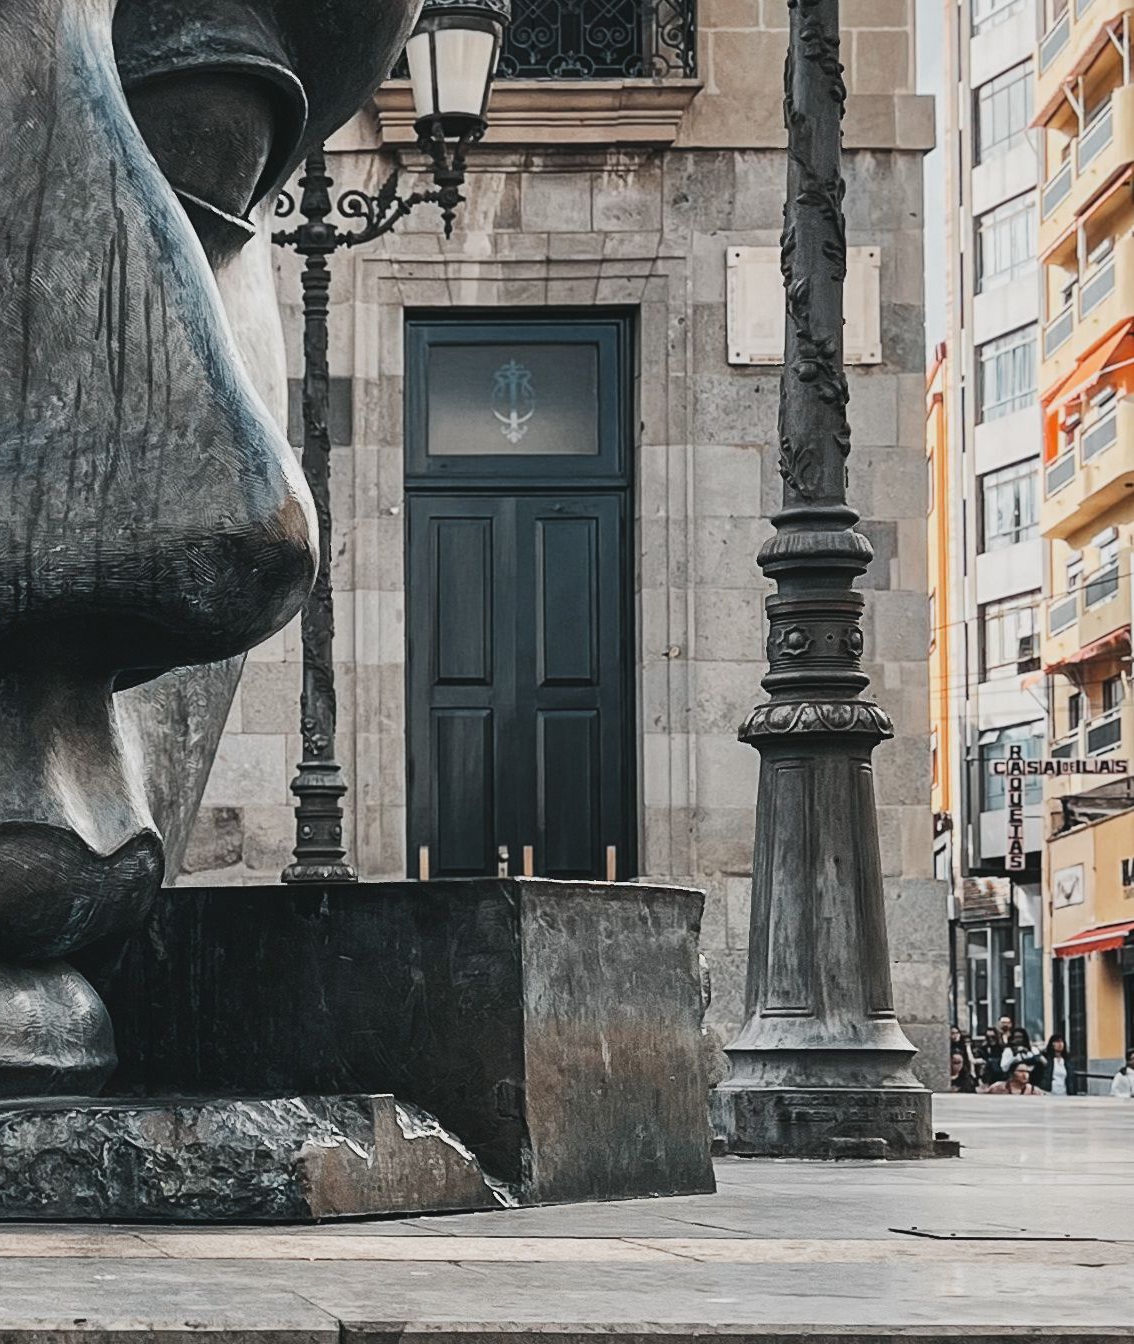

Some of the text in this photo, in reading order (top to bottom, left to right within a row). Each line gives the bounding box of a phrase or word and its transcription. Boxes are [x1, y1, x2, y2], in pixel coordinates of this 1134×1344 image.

[994, 760, 1056, 775] CASA
[1083, 760, 1128, 774] LAS
[1009, 746, 1023, 868] RAQUETAS
